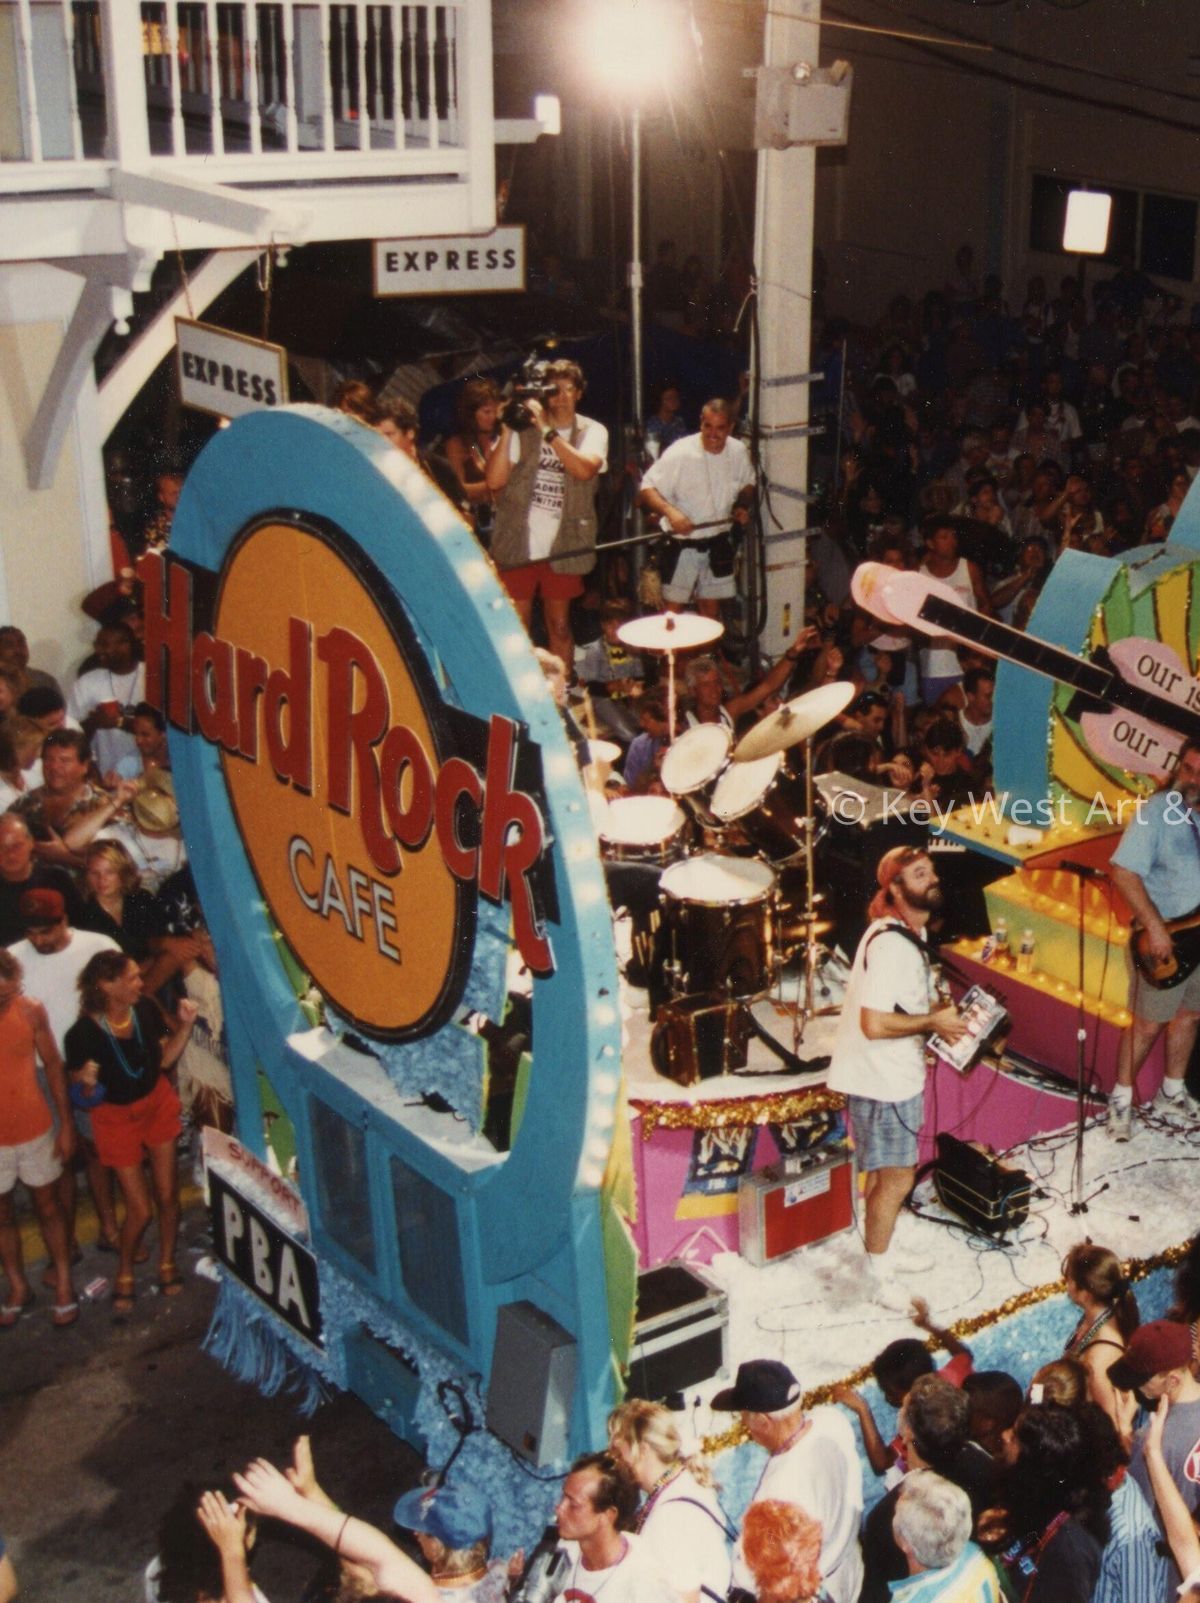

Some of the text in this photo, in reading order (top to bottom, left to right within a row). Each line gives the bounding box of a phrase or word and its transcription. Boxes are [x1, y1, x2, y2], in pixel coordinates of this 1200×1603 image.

[385, 249, 516, 273] EXPRESS
[182, 351, 277, 406] EXPRESS
[1137, 654, 1183, 692] our
[136, 549, 557, 976] Hard Rock
[1112, 720, 1159, 759] our
[288, 834, 402, 965] CAFE
[222, 1191, 312, 1330] PBA
